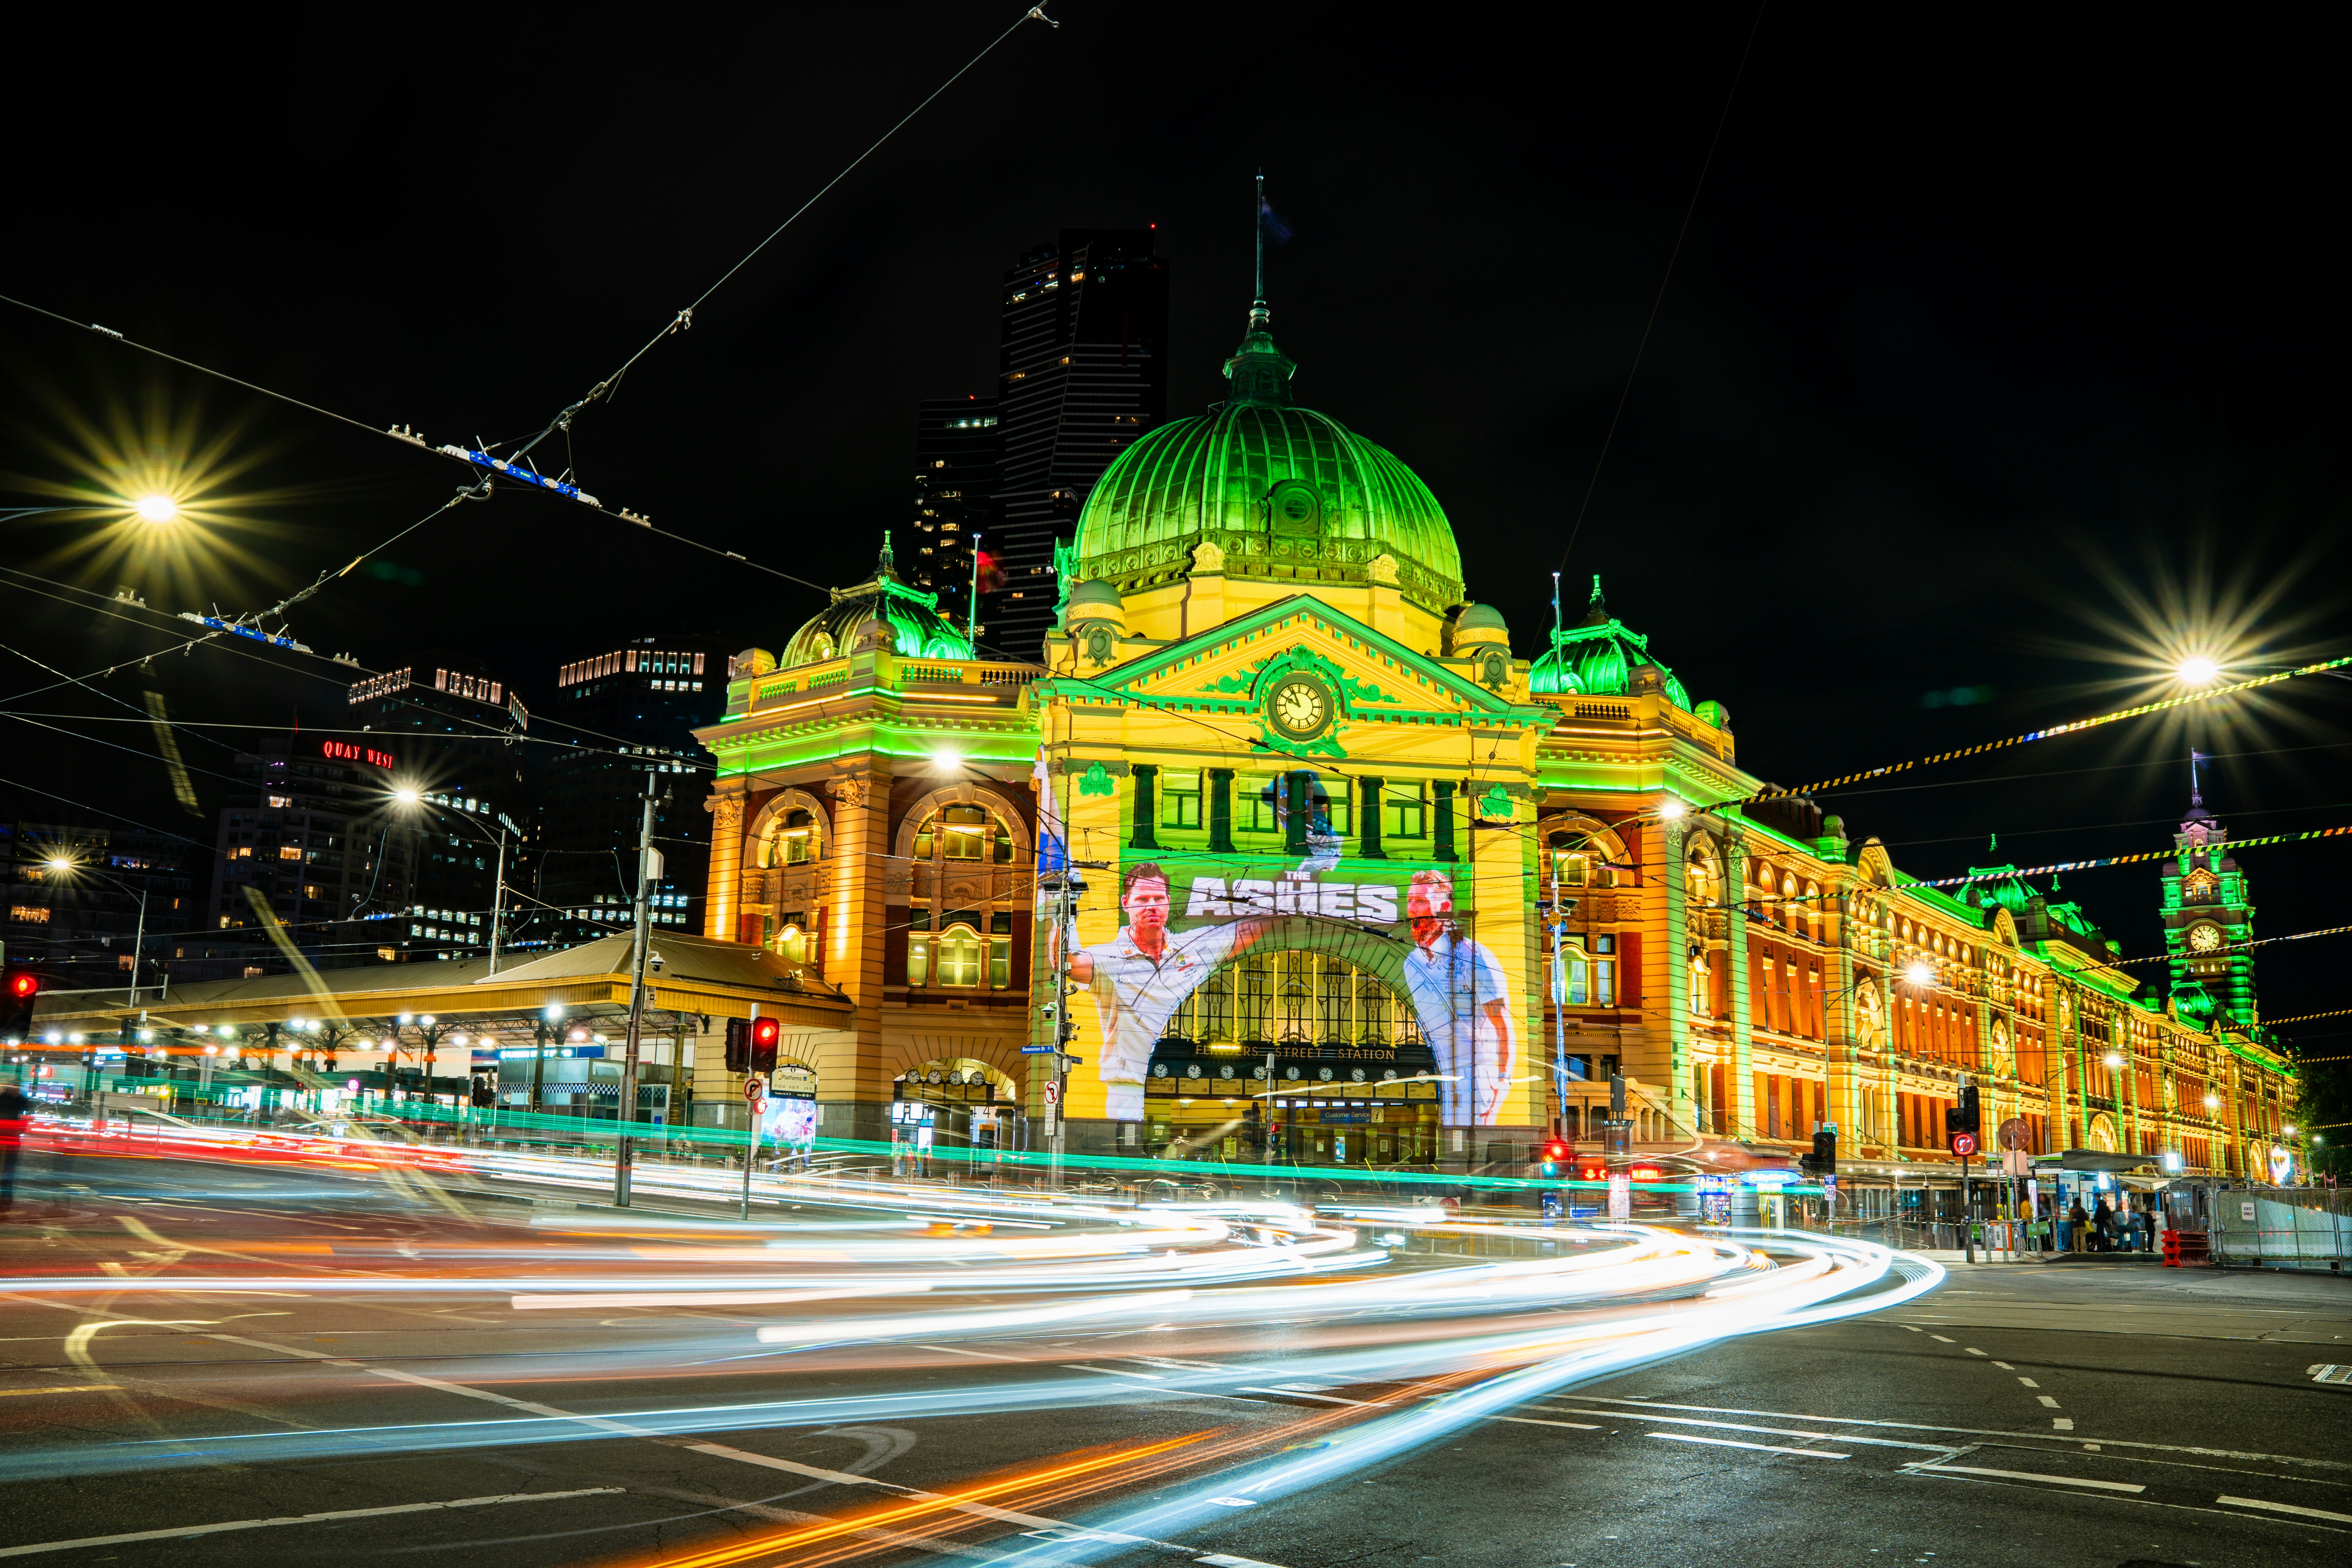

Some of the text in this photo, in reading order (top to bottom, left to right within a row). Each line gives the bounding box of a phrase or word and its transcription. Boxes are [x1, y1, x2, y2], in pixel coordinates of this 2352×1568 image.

[324, 741, 393, 769] QUAY WEST
[1284, 870, 1310, 880] THE
[1186, 877, 1398, 923] ASHES
[1275, 1047, 1322, 1058] STREET
[1338, 1049, 1394, 1060] STATION
